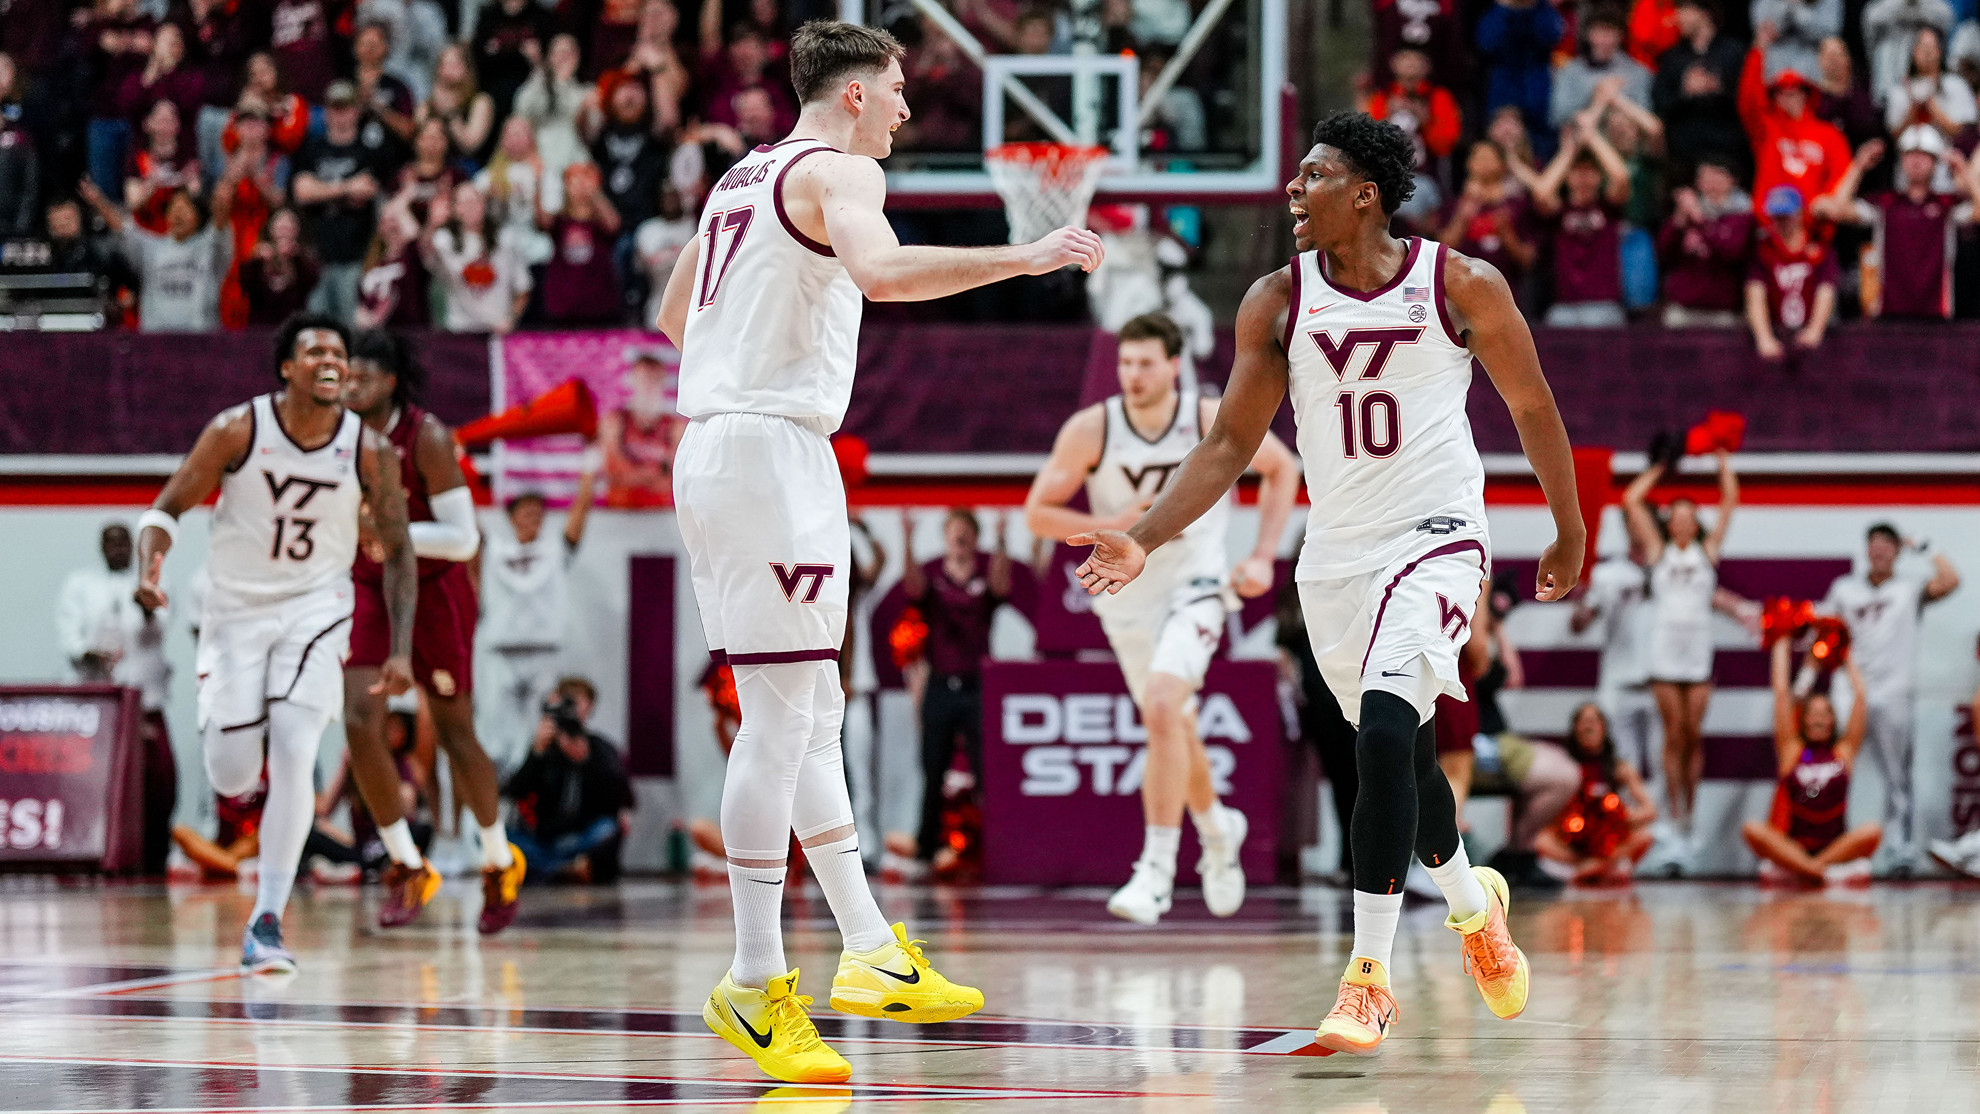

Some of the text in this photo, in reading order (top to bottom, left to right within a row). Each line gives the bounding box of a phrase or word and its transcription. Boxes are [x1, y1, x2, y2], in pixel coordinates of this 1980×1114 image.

[716, 159, 777, 193] AVDALAS
[698, 204, 755, 312] 17
[1307, 325, 1427, 383] VT
[1334, 389, 1402, 460] 10
[261, 469, 341, 510] VT
[1120, 460, 1182, 495] VT
[270, 515, 319, 561] 13
[768, 561, 835, 604] VT
[1435, 591, 1470, 643] VT
[1002, 693, 1252, 744] DELA
